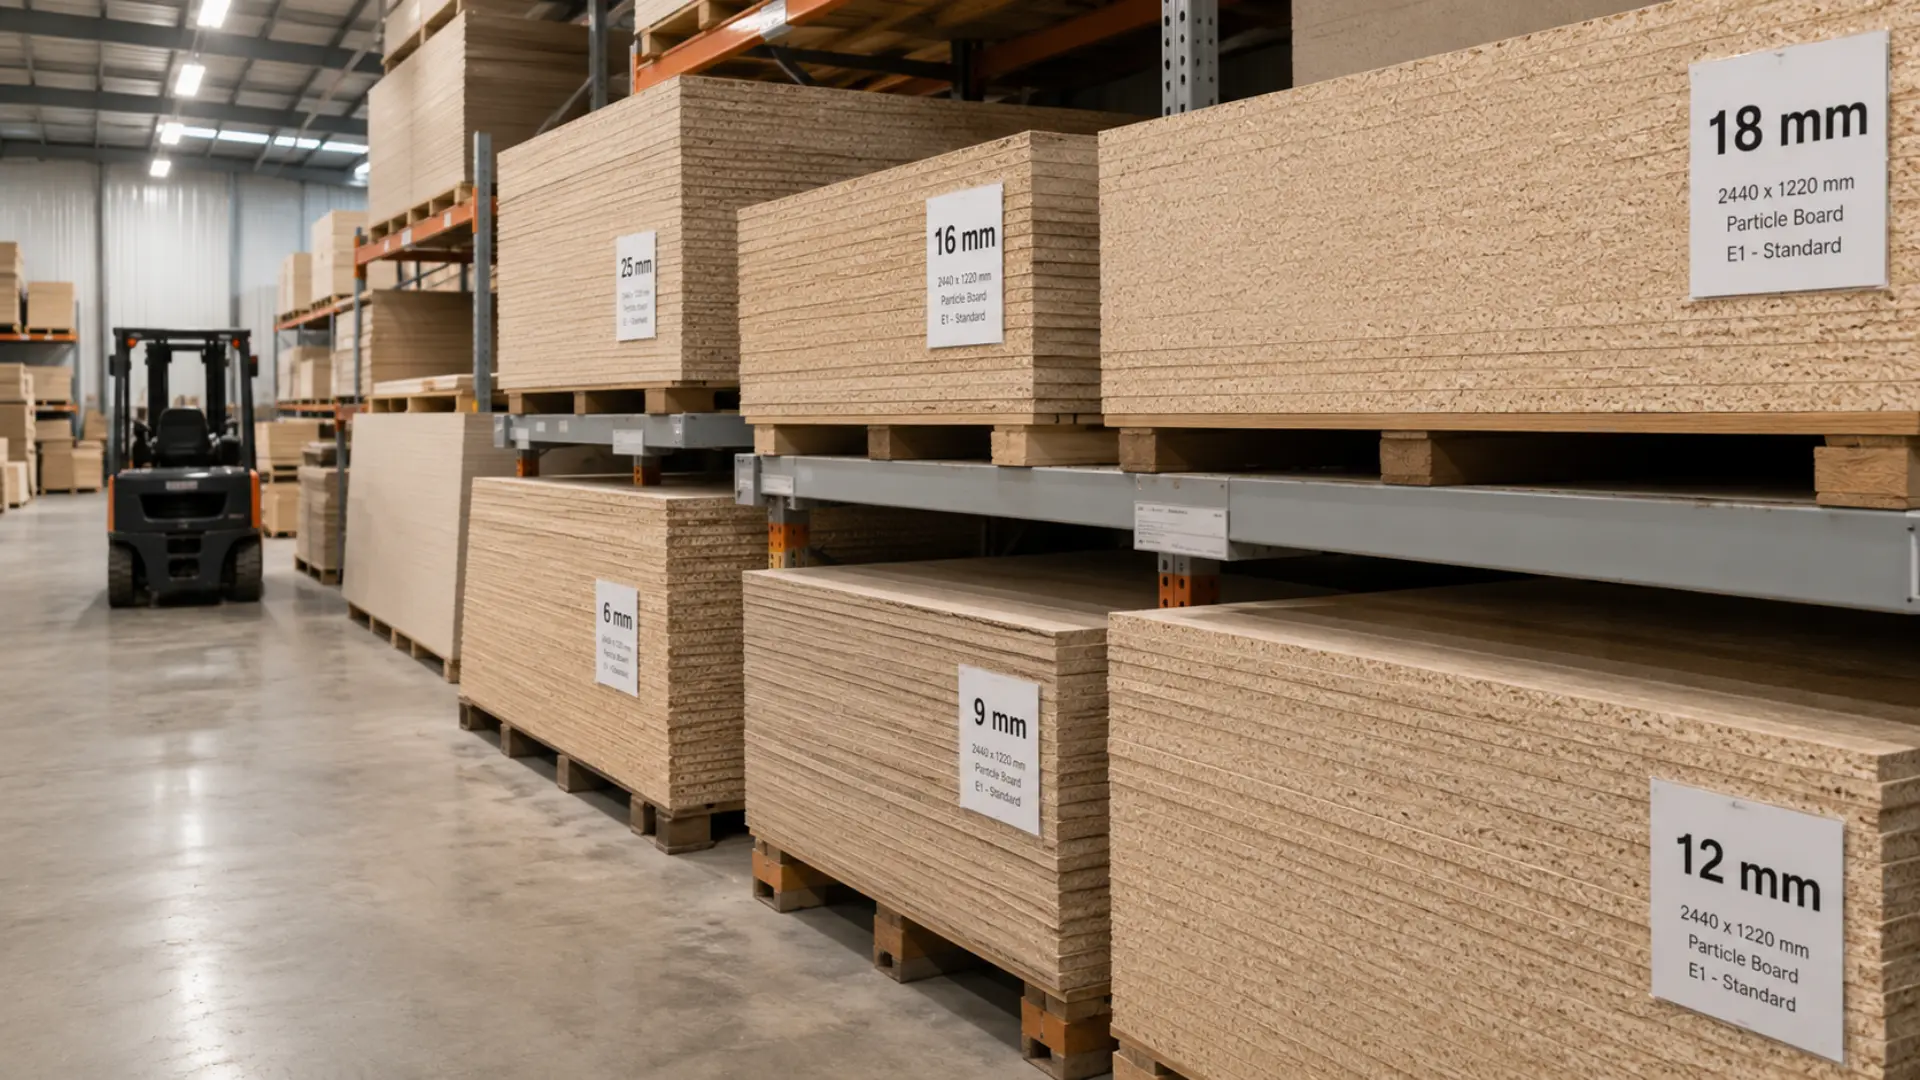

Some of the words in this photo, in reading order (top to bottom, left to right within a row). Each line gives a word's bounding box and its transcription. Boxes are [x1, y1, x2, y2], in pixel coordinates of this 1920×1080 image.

[1710, 105, 1762, 155] 18
[1781, 102, 1867, 146] mm
[1718, 184, 1758, 204] 2440
[1764, 186, 1772, 198] x
[1778, 177, 1817, 197] 1220
[1823, 176, 1854, 192] mm
[1727, 211, 1787, 232] Particle
[1794, 205, 1843, 226] Board
[936, 225, 956, 255] 16
[962, 226, 995, 252] mm
[1728, 245, 1745, 262] E1
[1764, 237, 1841, 258] Standard
[622, 257, 632, 278] 25
[635, 259, 651, 275] mm
[938, 275, 953, 287] 2440
[962, 273, 976, 284] 1220
[979, 272, 991, 282] mm
[941, 294, 965, 305] Particle
[967, 290, 986, 302] Board
[941, 314, 949, 325] E1
[956, 311, 985, 323] Standard
[604, 602, 610, 623] 6
[613, 610, 632, 630] mm
[975, 698, 985, 726] 9
[993, 711, 1026, 739] mm
[972, 743, 988, 757] 2440
[996, 751, 1012, 766] 1220
[1013, 760, 1026, 771] mm
[975, 763, 999, 780] Particle
[1001, 771, 1021, 788] Board
[975, 781, 984, 792] E1
[990, 787, 1021, 807] Standard
[1677, 833, 1723, 884] 12
[1741, 861, 1820, 912] mm
[1680, 904, 1718, 929] 2440
[1724, 920, 1732, 934] x
[1737, 923, 1774, 947] 1220
[1780, 939, 1809, 959] mm
[1689, 934, 1746, 967] Particle
[1752, 955, 1798, 984] Board
[1689, 962, 1705, 981] E1
[1723, 974, 1796, 1012] Standard
